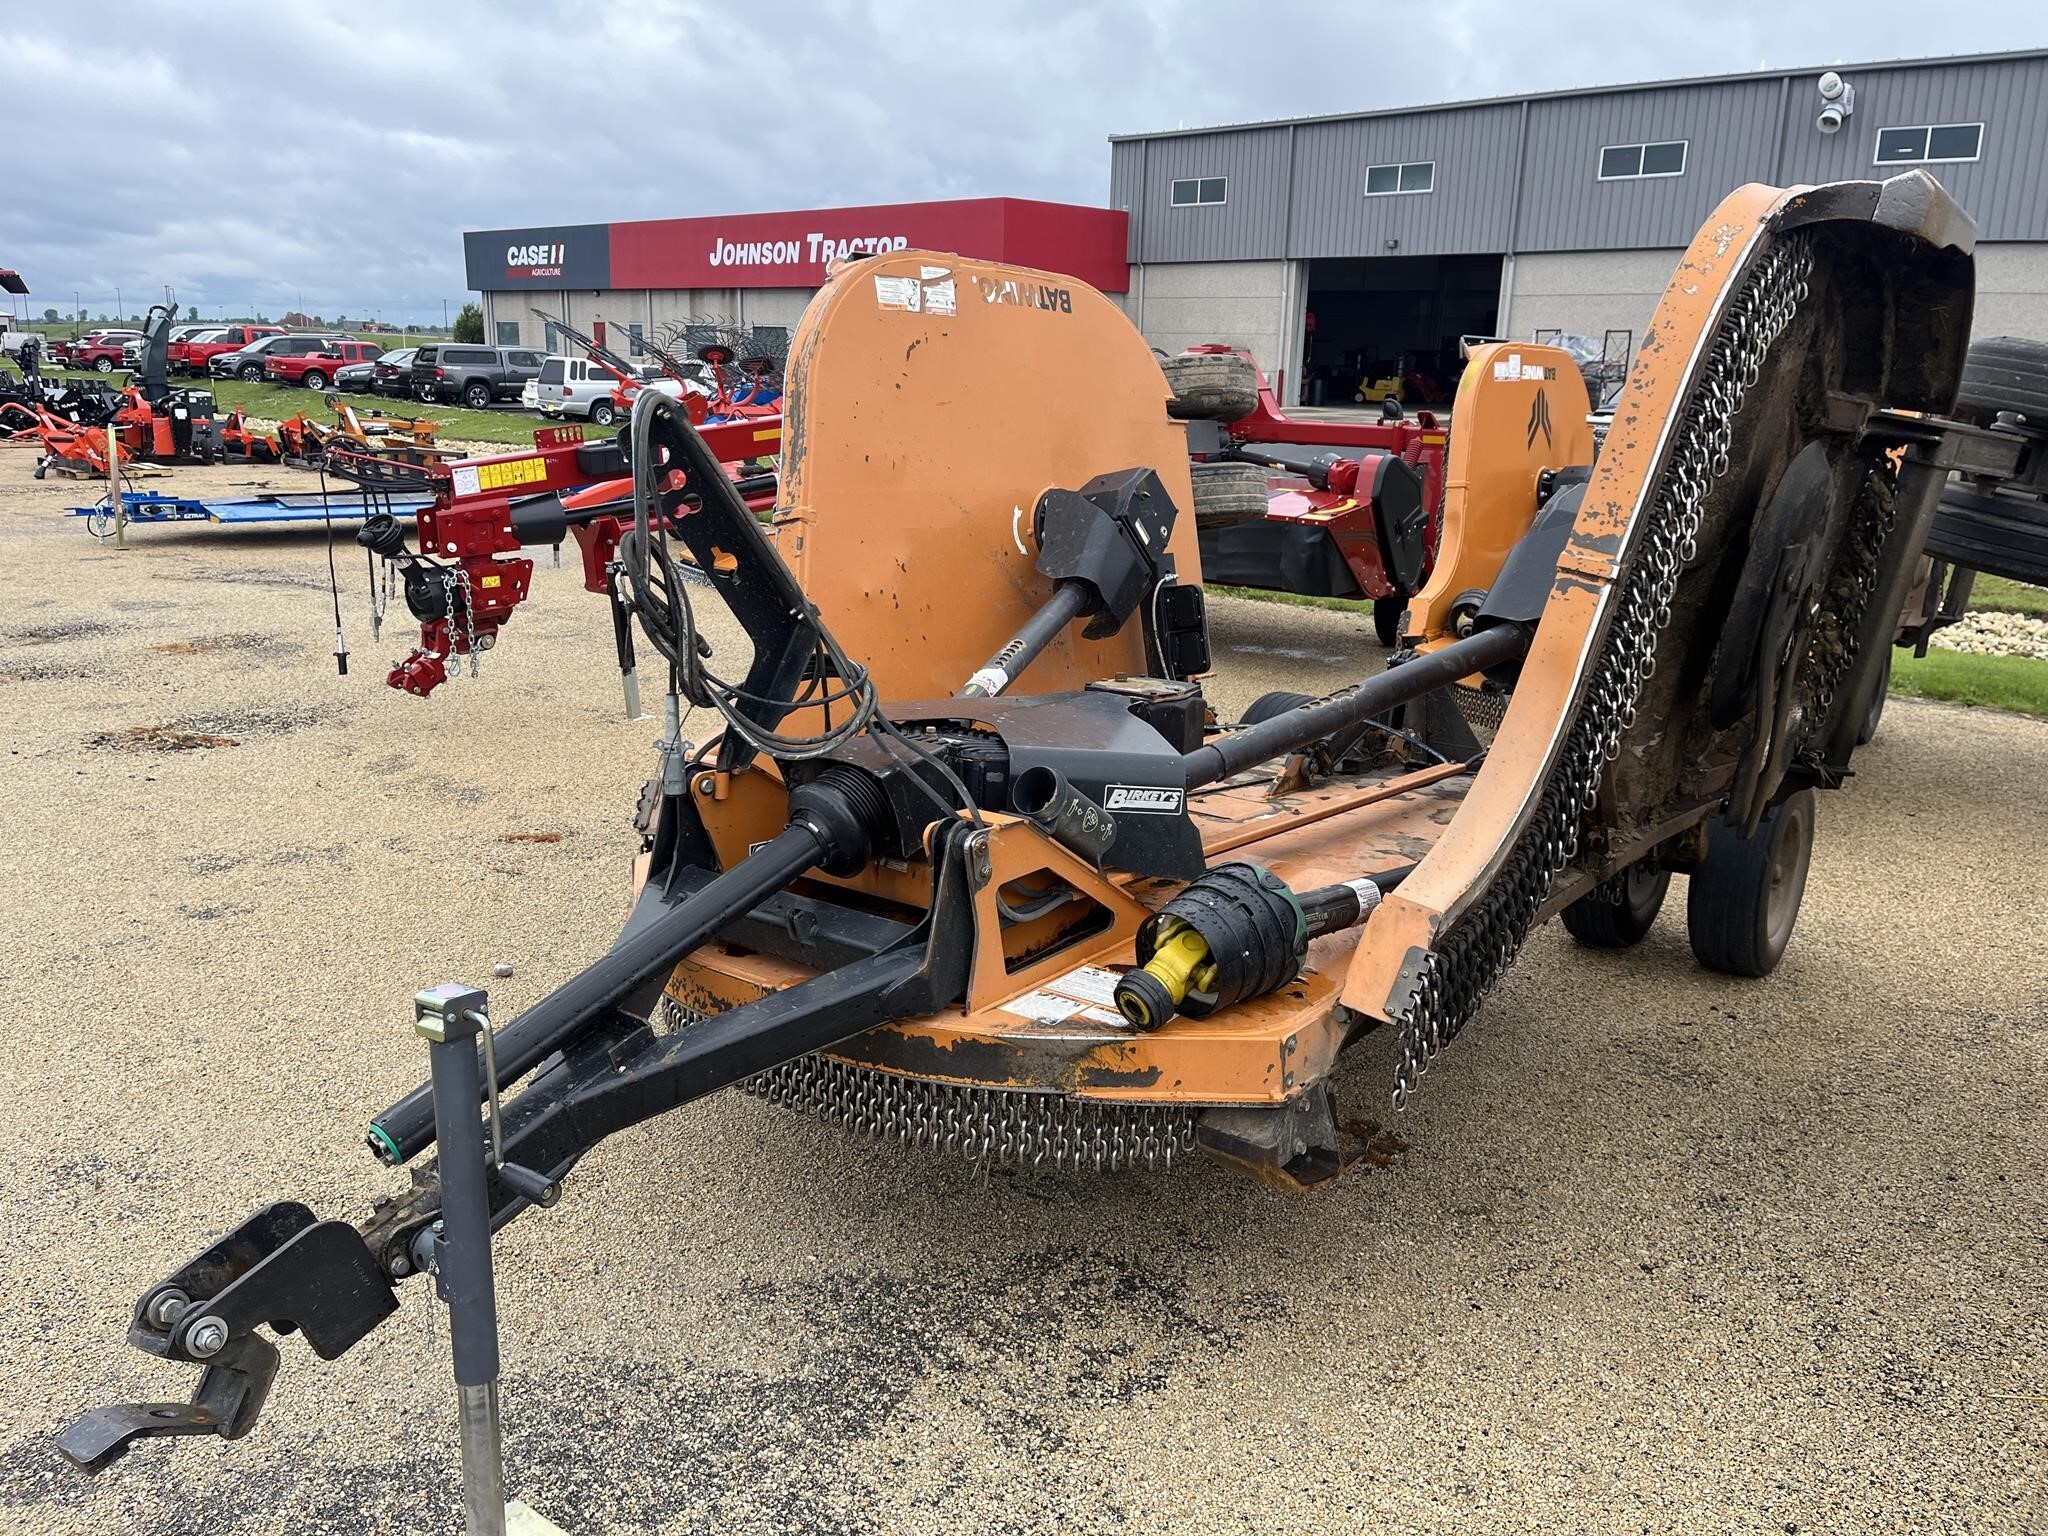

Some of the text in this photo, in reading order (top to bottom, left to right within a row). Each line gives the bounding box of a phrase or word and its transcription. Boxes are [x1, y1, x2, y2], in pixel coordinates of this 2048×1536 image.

[507, 245, 549, 266] CASE
[709, 237, 800, 266] JOHNSON
[531, 268, 561, 276] AGRICULTURE
[1106, 789, 1181, 809] BIRKEY'S
